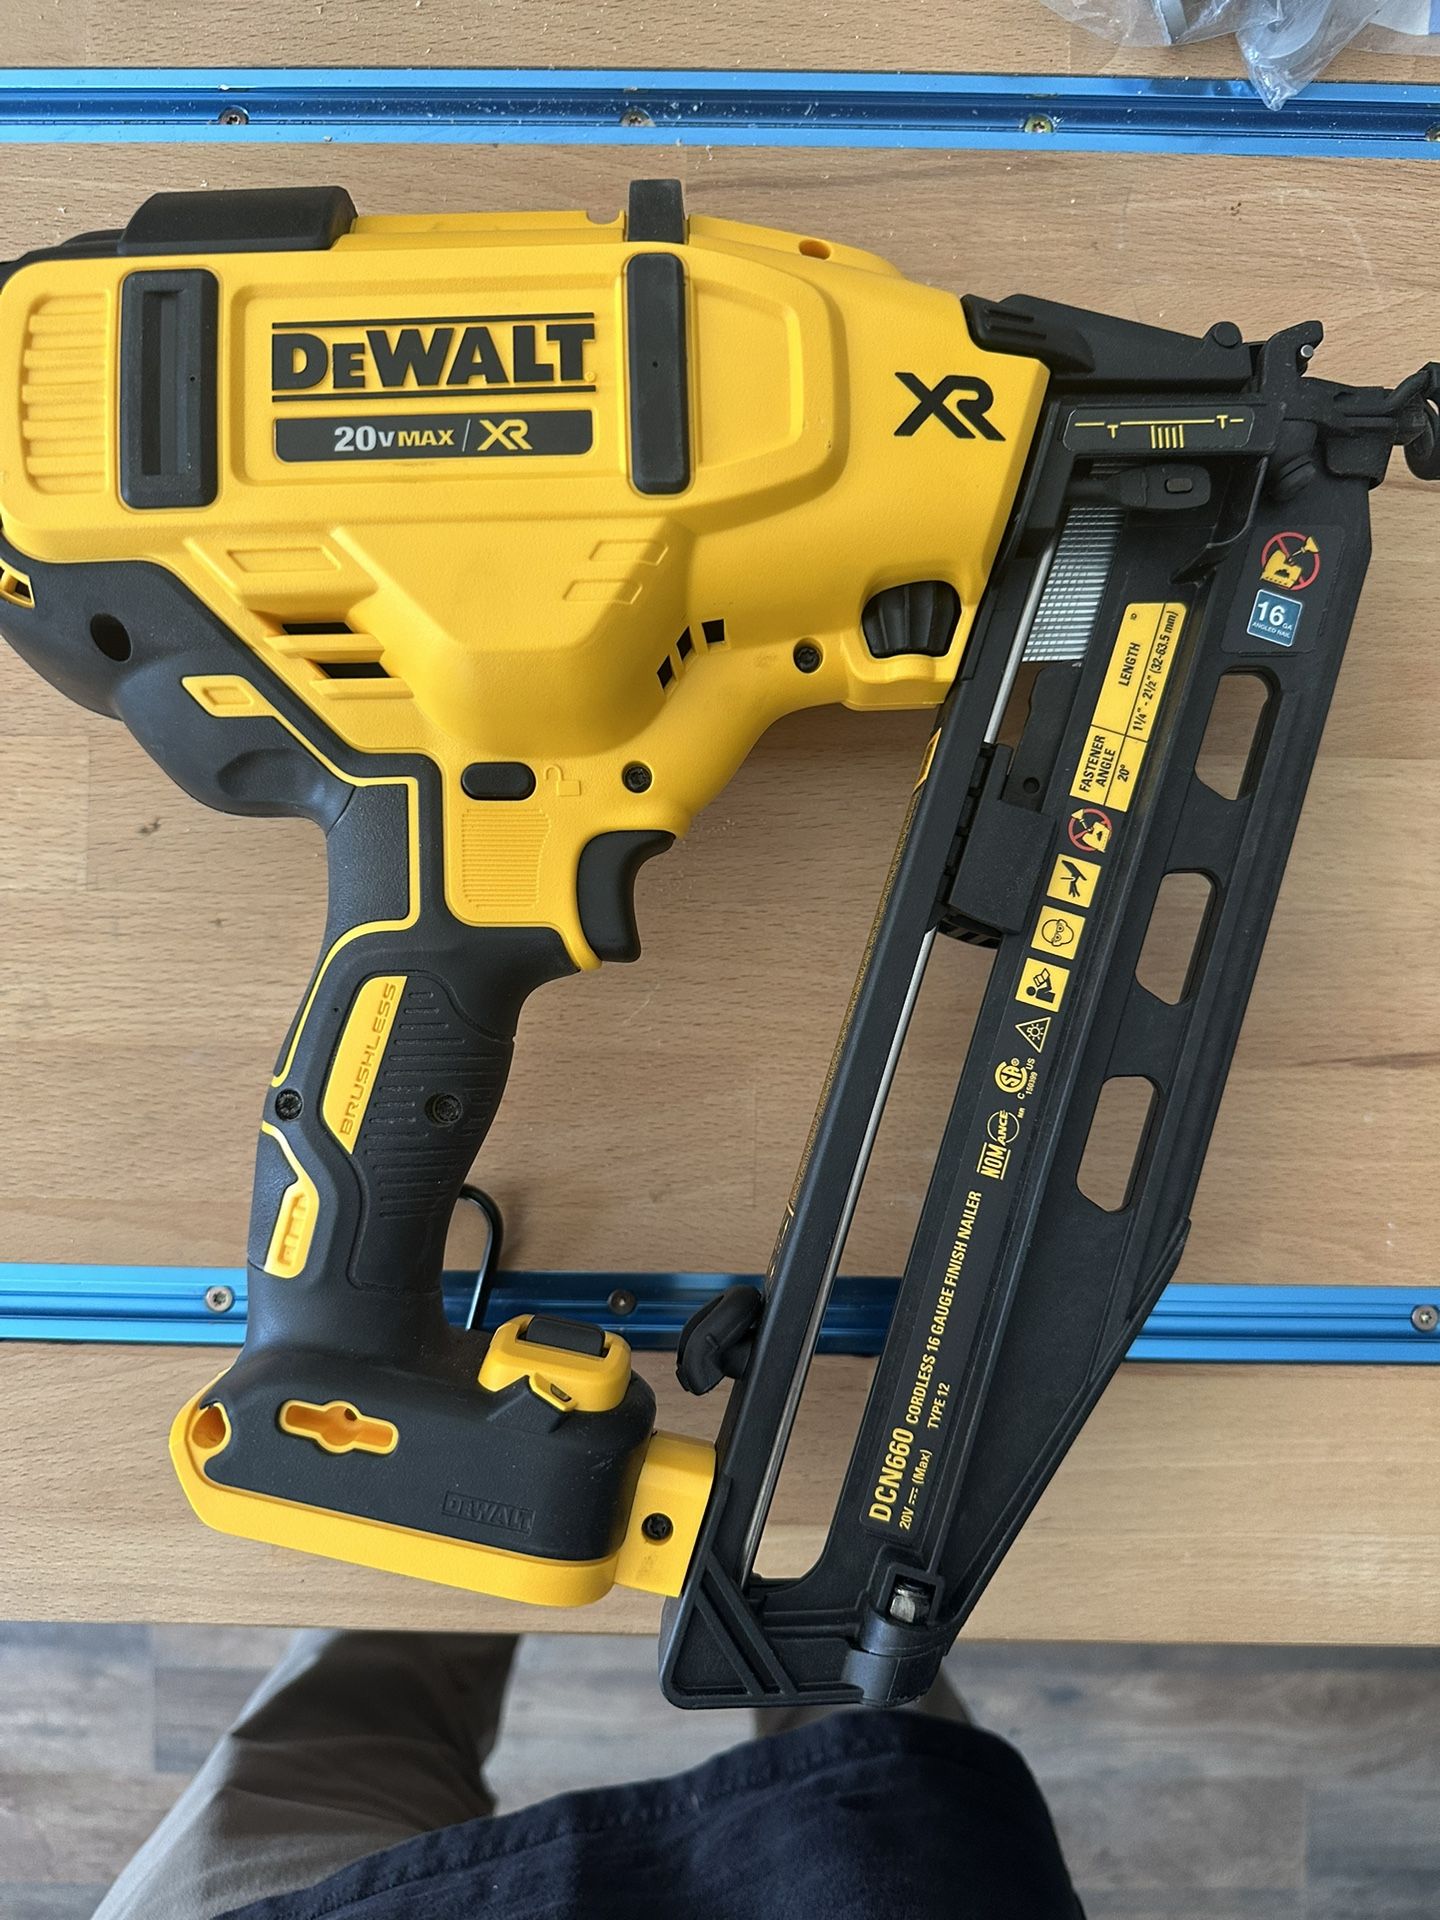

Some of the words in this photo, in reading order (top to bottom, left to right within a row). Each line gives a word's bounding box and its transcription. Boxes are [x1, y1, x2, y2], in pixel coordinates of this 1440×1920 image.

[893, 371, 1006, 441] XR
[477, 418, 533, 451] XR
[1252, 621, 1276, 634] ANGLED
[1257, 601, 1285, 626] 16
[1118, 642, 1141, 686] LENGTH
[1149, 634, 1170, 674] (32-63.5
[1164, 611, 1179, 633] mm)
[1079, 734, 1106, 793] FASTENER
[1095, 748, 1116, 788] ANGLE
[339, 982, 396, 1135] BRUSHLESS
[1025, 1057, 1036, 1071] US
[980, 1143, 1007, 1179] NOM
[997, 1109, 1009, 1147] ANCE
[957, 1190, 982, 1240] NAILER
[943, 1240, 968, 1287] FINISH
[930, 1287, 955, 1335] GAUGE
[926, 1336, 941, 1352] 16
[905, 1354, 936, 1424] CORDLESS
[868, 1427, 914, 1522] DCN660
[899, 1506, 914, 1530] 20V
[911, 1449, 933, 1484] (Max)
[927, 1397, 946, 1429] TYPE
[937, 1382, 951, 1396] 12
